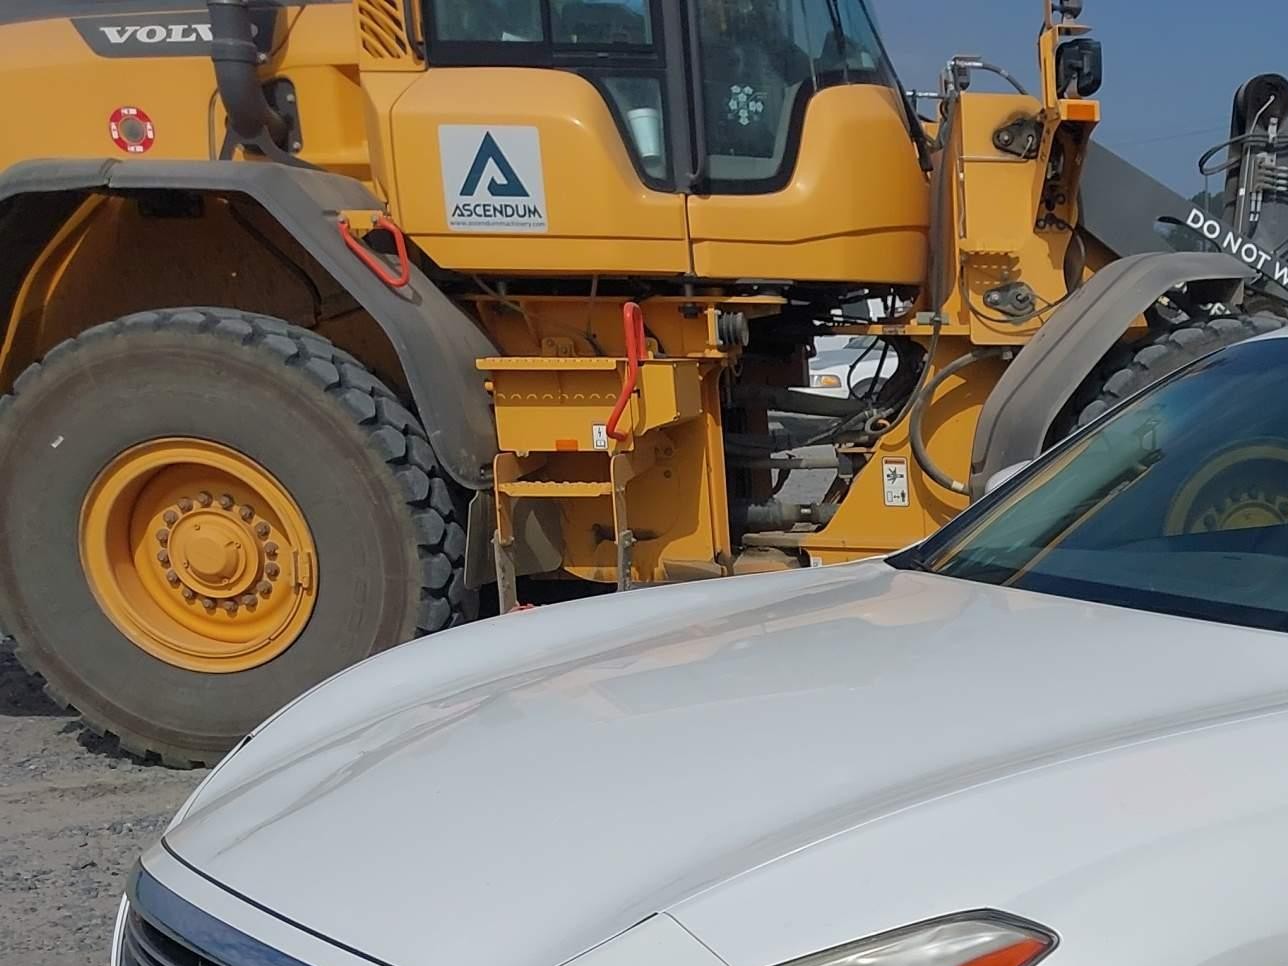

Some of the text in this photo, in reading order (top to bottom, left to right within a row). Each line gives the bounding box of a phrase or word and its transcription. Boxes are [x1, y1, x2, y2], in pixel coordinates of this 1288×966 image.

[100, 24, 258, 43] VOLV
[452, 203, 542, 219] ASCENDUM
[1187, 208, 1220, 239] DO
[1223, 231, 1271, 270] NOT
